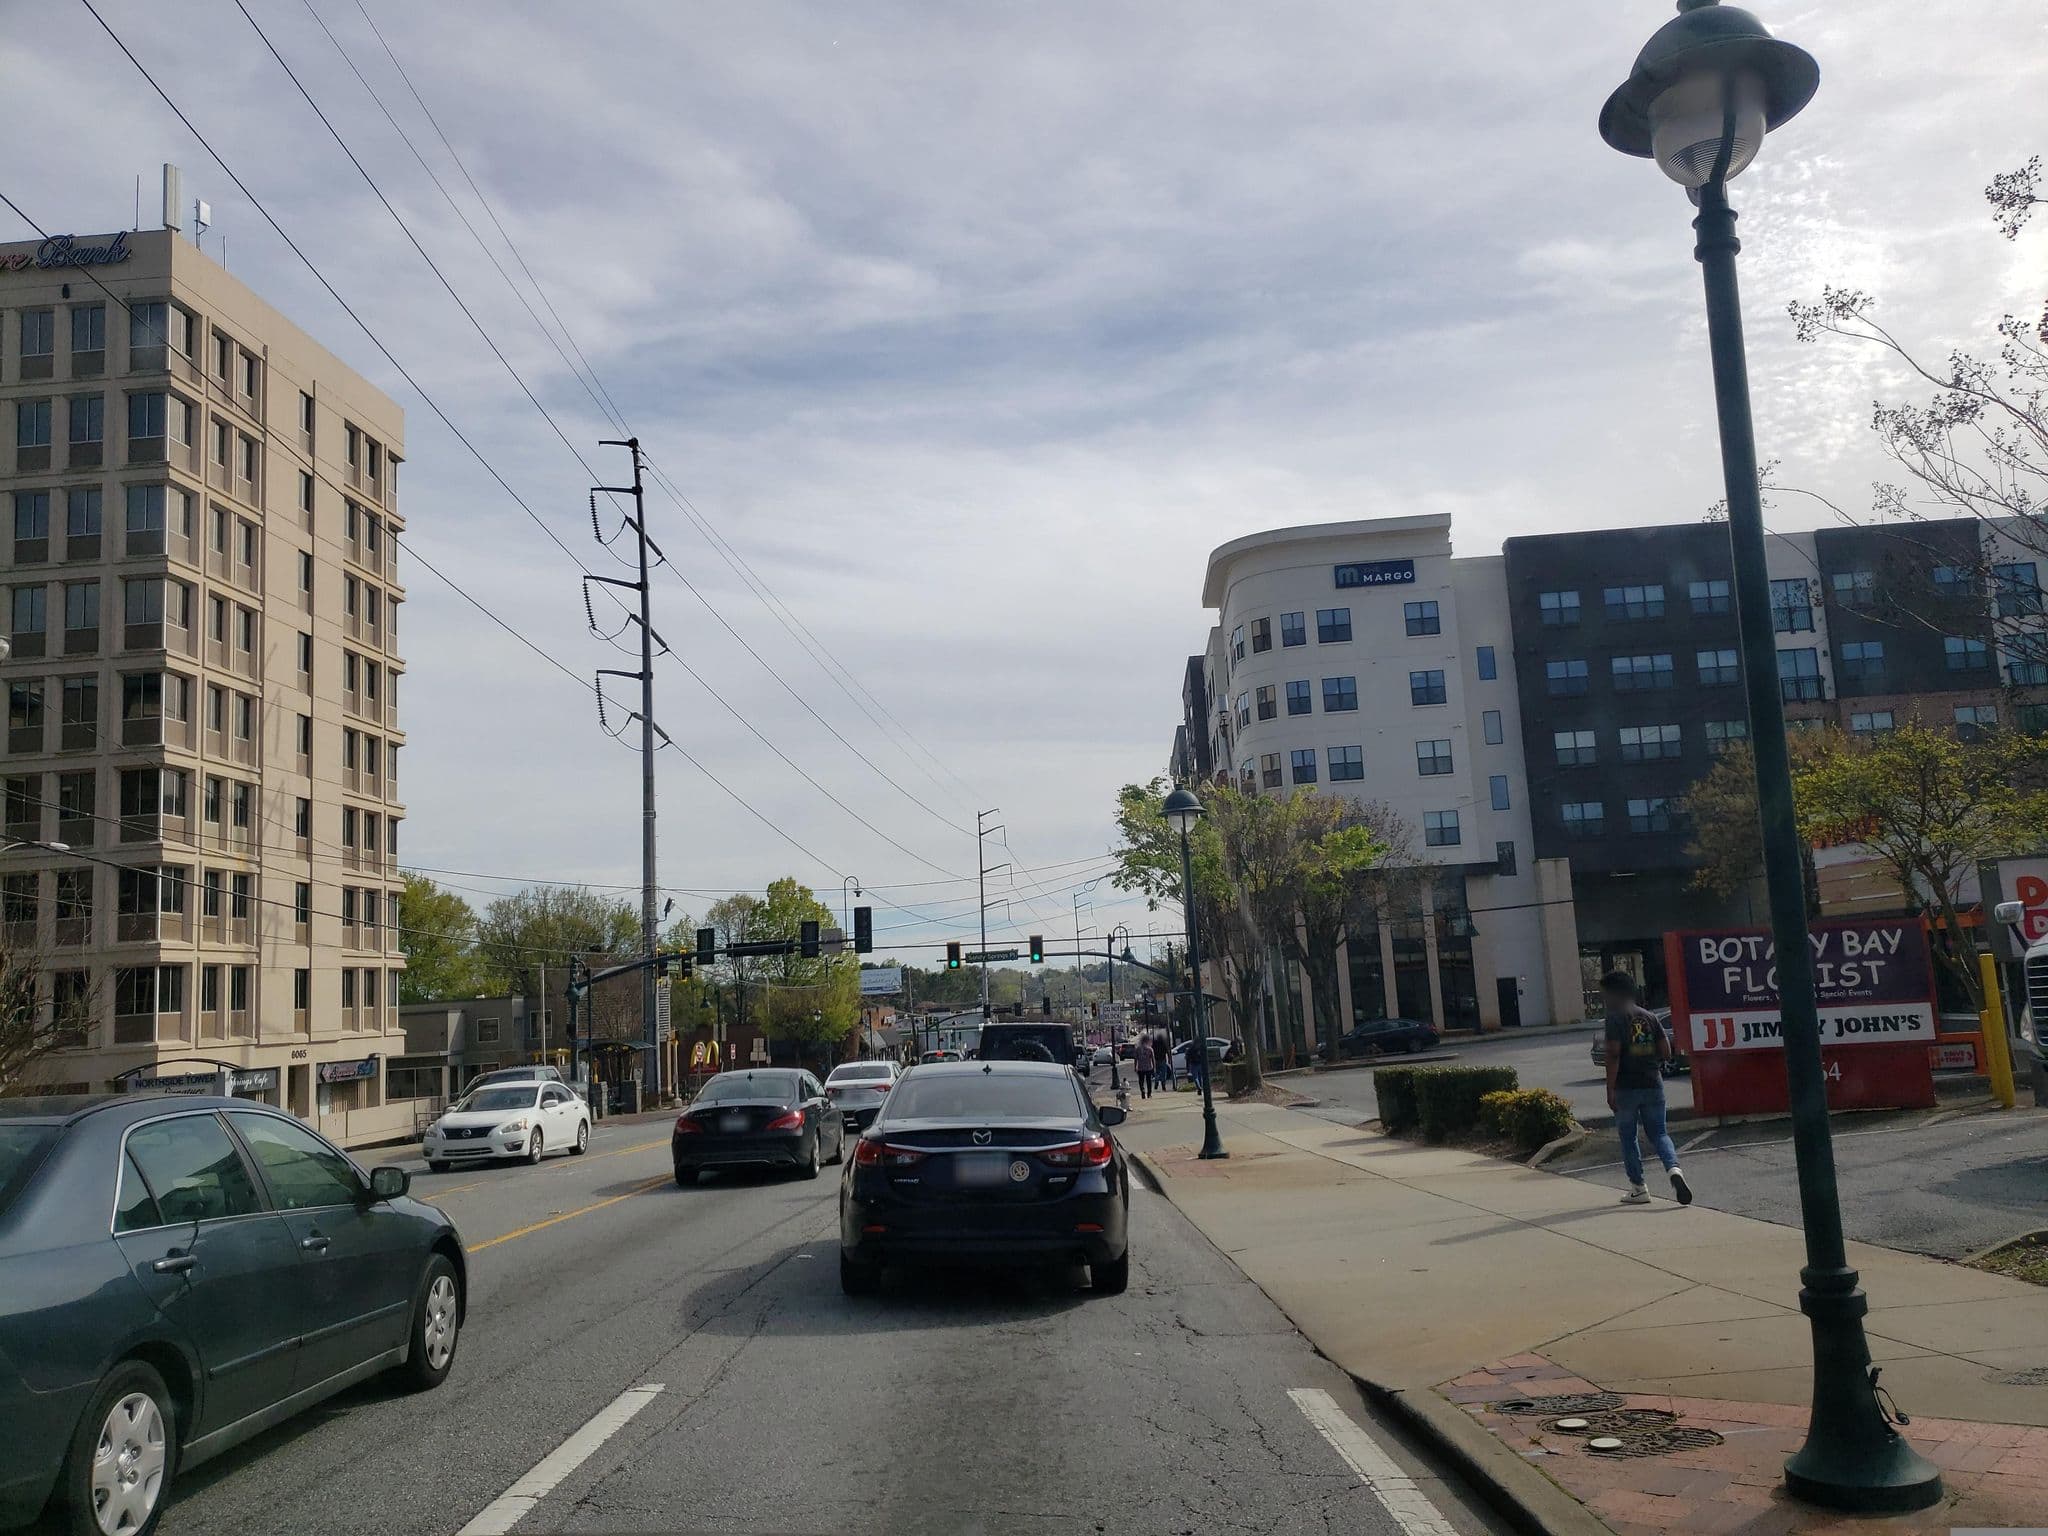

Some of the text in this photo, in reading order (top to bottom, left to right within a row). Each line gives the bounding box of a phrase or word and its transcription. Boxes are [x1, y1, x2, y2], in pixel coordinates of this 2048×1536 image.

[36, 231, 132, 268] Bank
[1363, 571, 1412, 582] MARGO
[1700, 928, 1902, 965] BOTY BAY
[1723, 960, 1886, 994] FLIST
[1704, 1018, 1736, 1049] JJ
[1835, 1014, 1921, 1037] JOHN'S
[135, 1074, 217, 1089] NORTHSIDE TOWER
